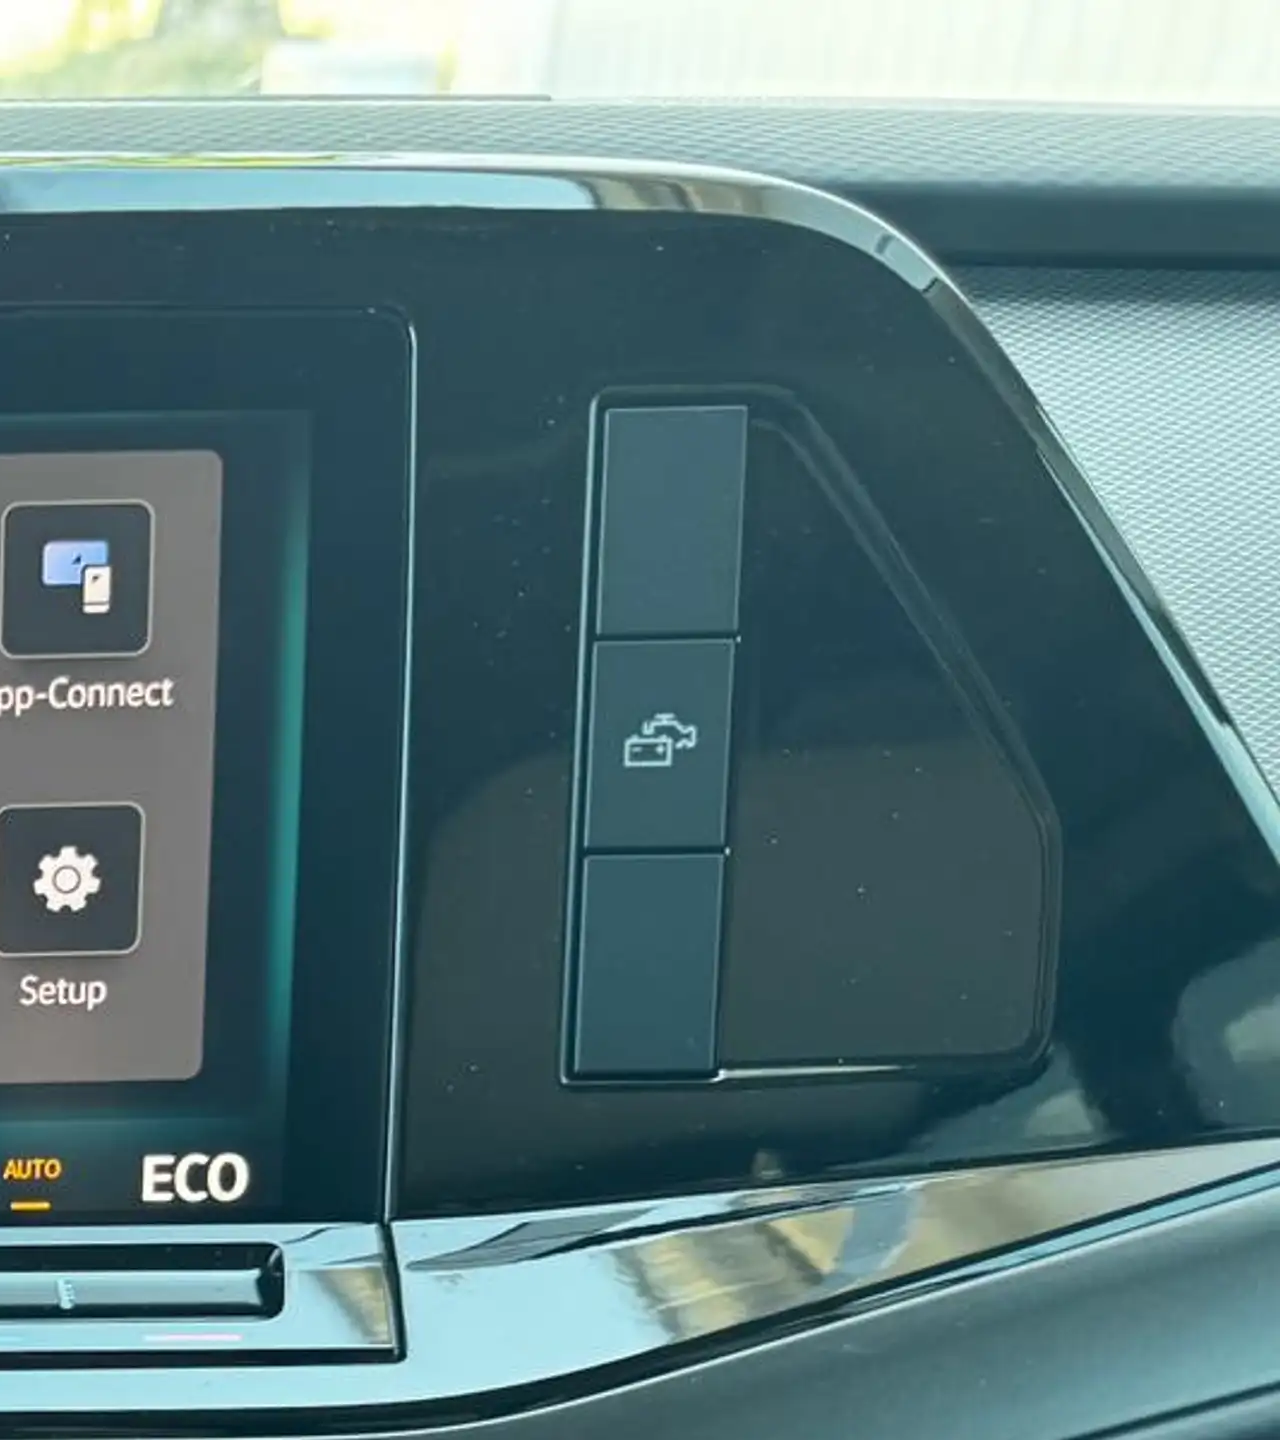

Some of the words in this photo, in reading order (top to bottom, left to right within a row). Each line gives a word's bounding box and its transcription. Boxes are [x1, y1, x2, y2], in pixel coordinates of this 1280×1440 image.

[19, 974, 108, 1011] Setup
[2, 1158, 62, 1180] AUTO
[141, 1152, 250, 1203] ECO
